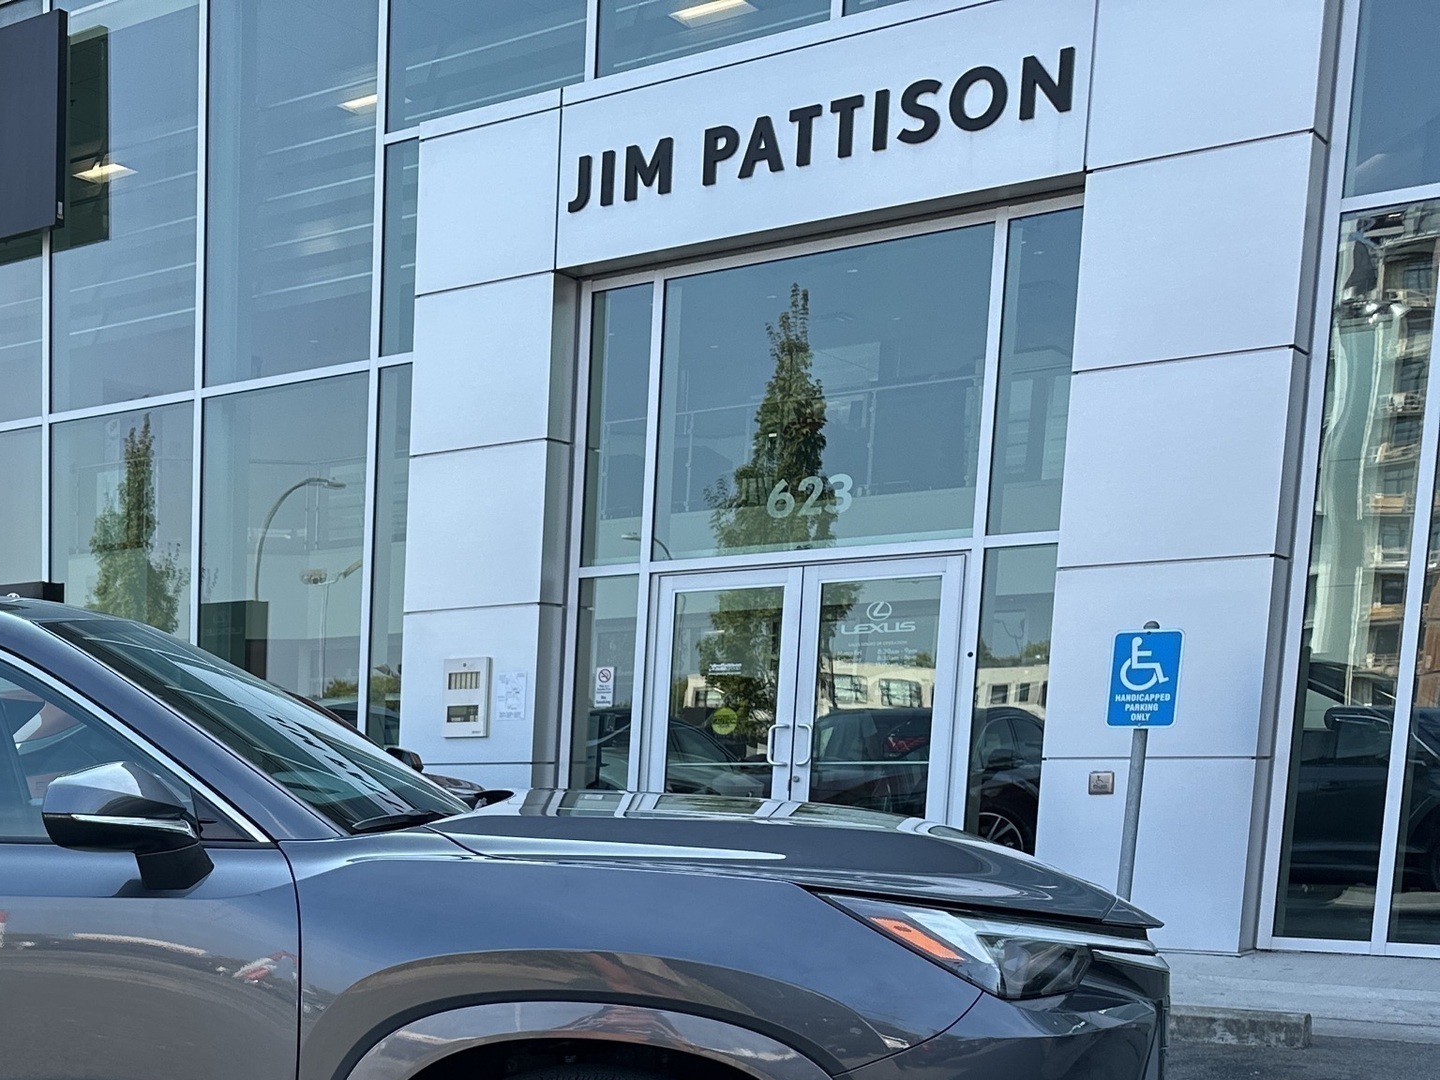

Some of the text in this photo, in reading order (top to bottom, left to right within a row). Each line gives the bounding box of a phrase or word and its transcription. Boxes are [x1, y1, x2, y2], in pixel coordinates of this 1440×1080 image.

[567, 46, 1076, 214] JIM PATTISON
[766, 472, 854, 519] 623
[841, 621, 917, 635] LEXUS
[1114, 693, 1171, 702] HANDICAPPED
[1124, 703, 1159, 712] PARKING
[1130, 713, 1151, 721] ONLY
